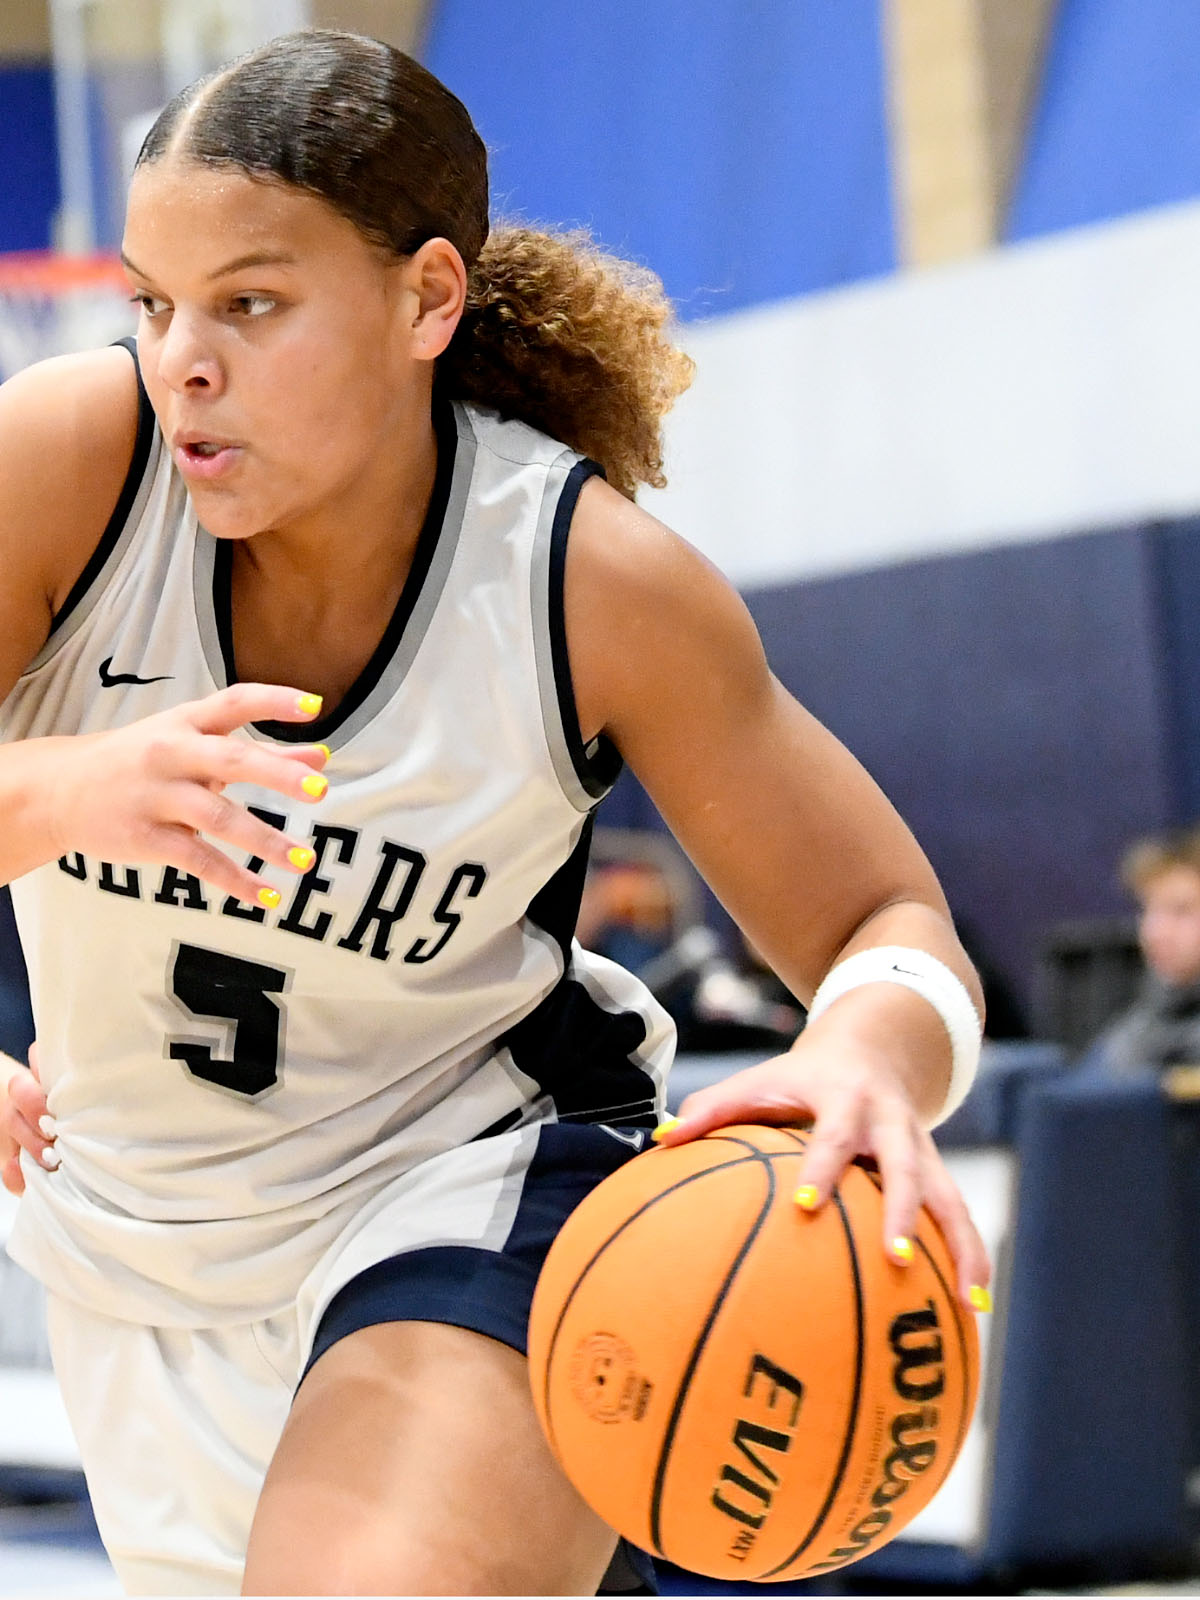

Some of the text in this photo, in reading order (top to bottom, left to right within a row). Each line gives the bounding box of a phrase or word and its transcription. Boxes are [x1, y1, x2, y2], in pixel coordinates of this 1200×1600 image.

[57, 802, 490, 966] LAZERS
[163, 938, 295, 1104] 5
[711, 1353, 805, 1530] EVO
